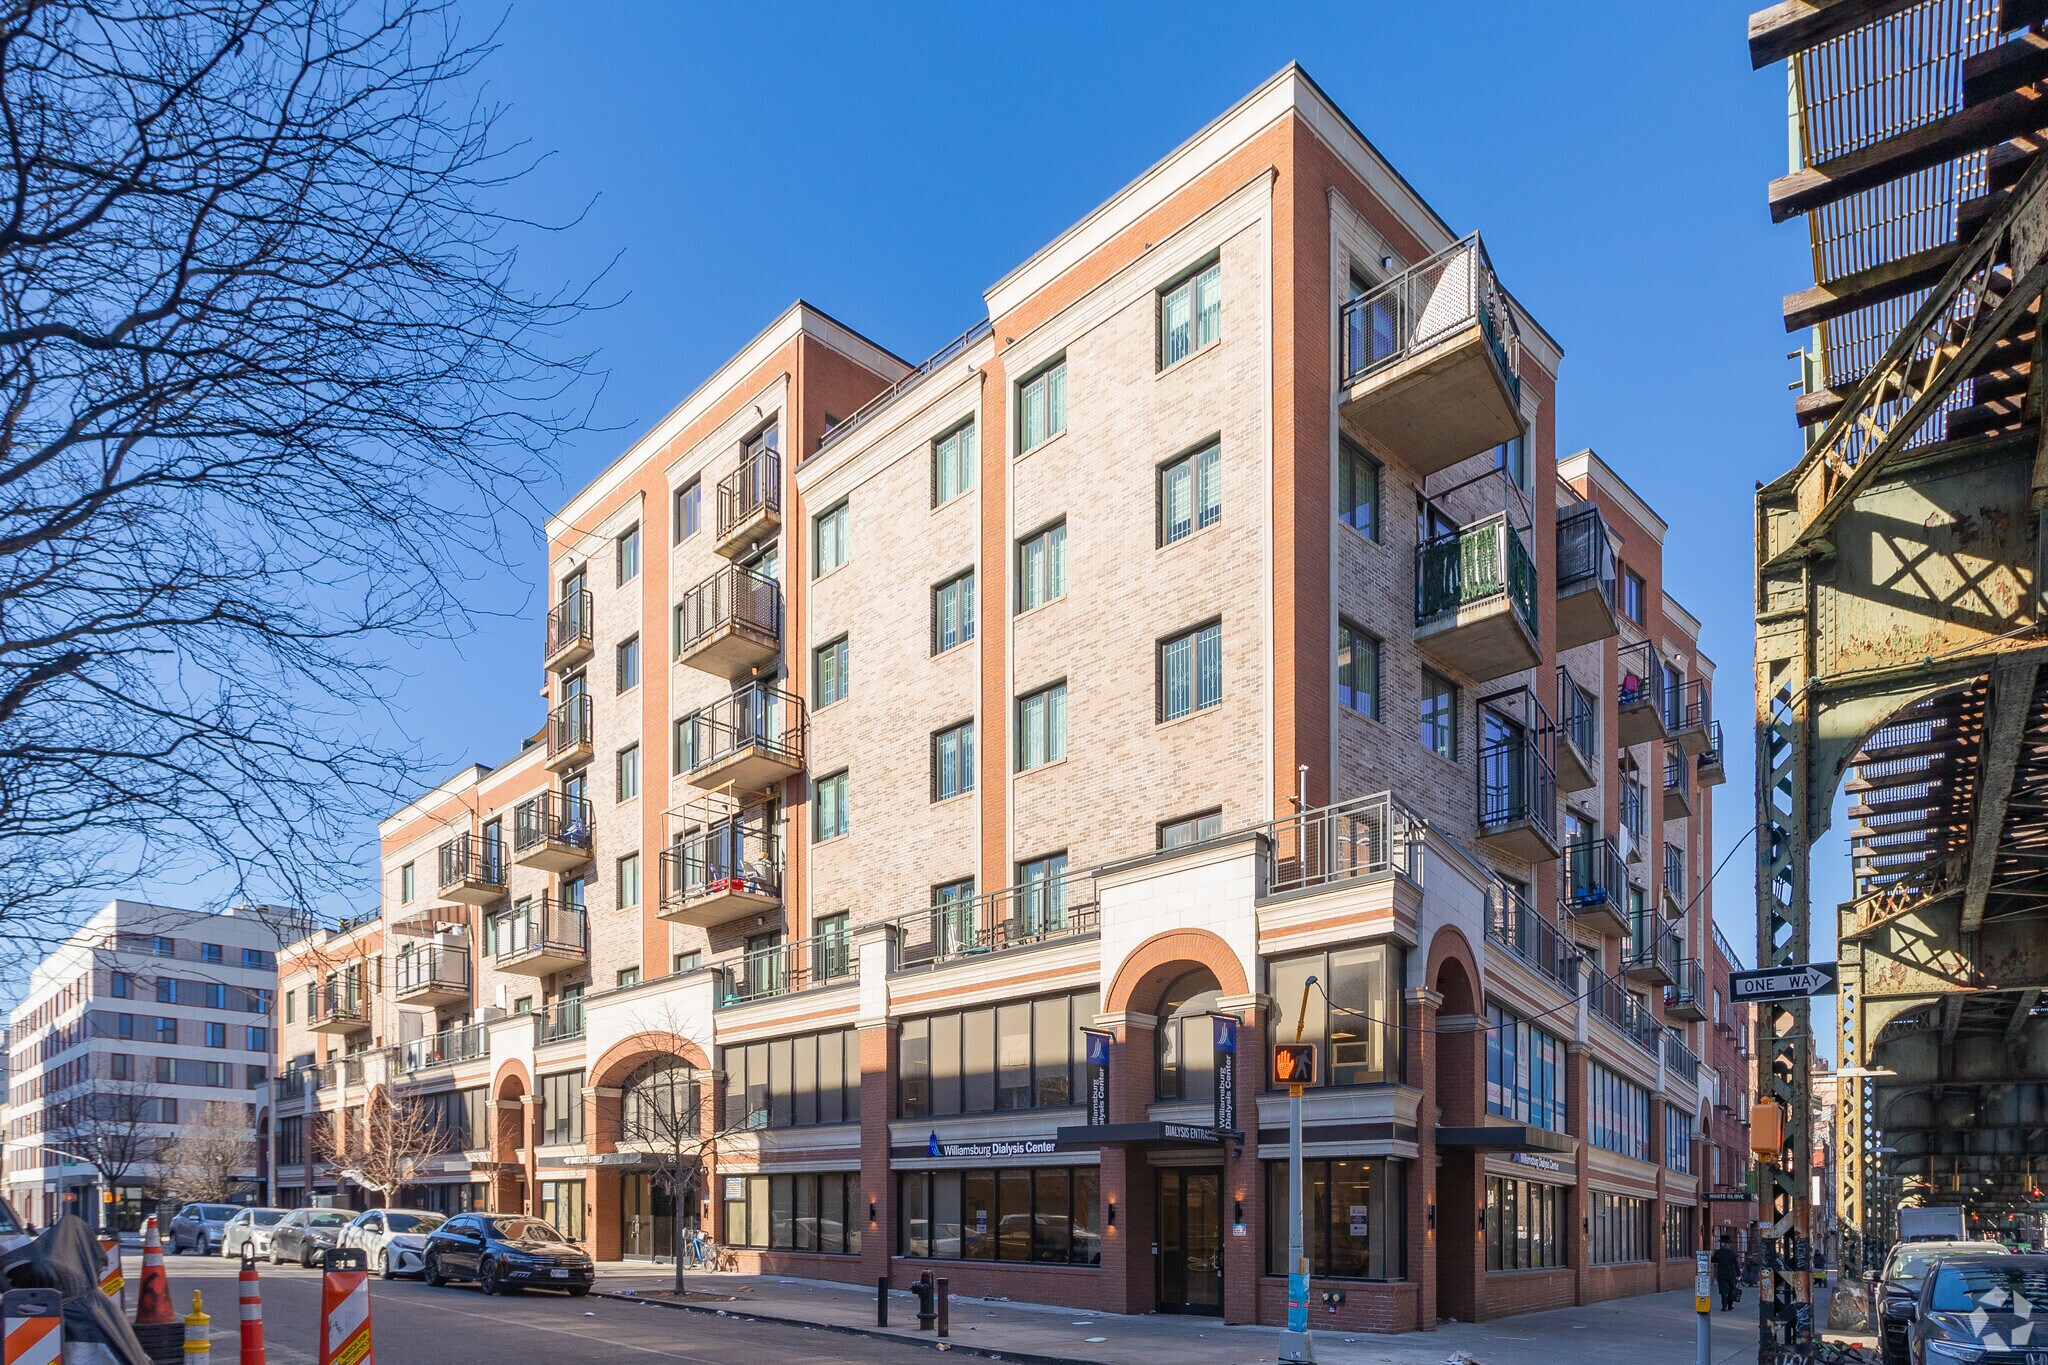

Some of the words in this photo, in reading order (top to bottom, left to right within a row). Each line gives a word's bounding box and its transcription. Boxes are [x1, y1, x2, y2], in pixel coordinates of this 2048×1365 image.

[1744, 978, 1775, 992] ONE
[1789, 974, 1821, 988] WAY
[1091, 1078, 1100, 1126] illiamsburg
[1218, 1067, 1227, 1129] Williamsburg
[1225, 1093, 1233, 1130] Dialysis
[1165, 1125, 1190, 1139] DIALYSIS
[943, 1144, 992, 1158] Williamsburg
[992, 1142, 1025, 1157] Dialysis
[1025, 1141, 1056, 1153] Center
